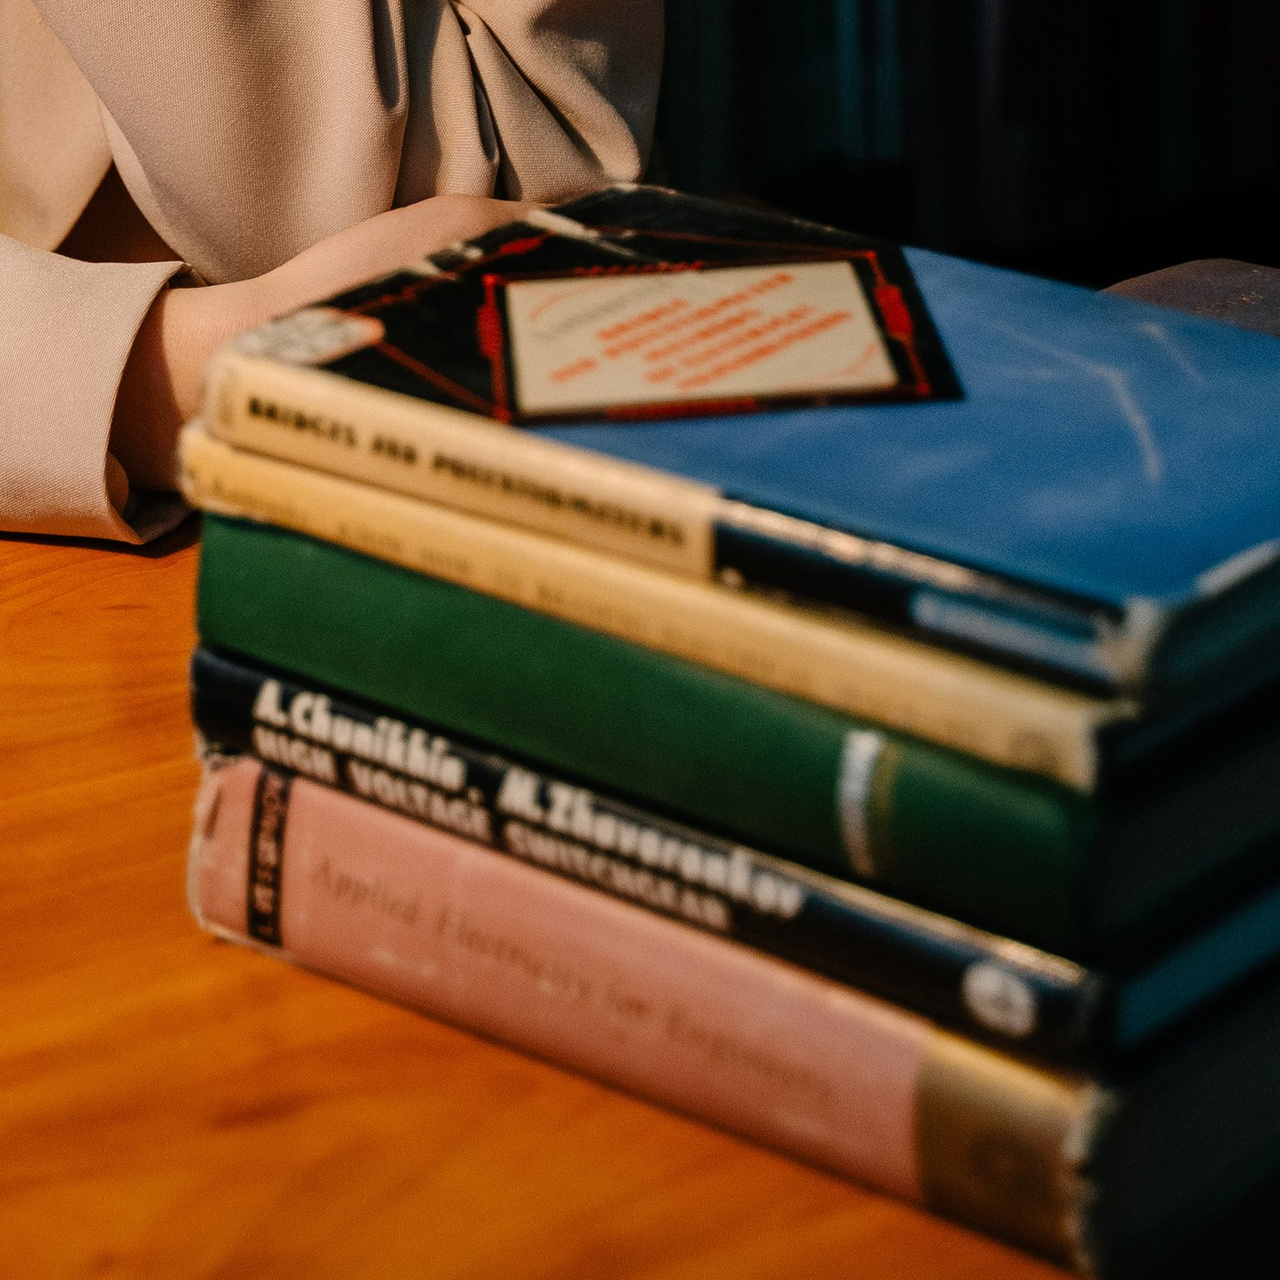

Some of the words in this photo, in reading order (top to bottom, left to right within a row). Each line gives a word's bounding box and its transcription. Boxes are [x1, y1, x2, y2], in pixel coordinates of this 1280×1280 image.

[253, 724, 338, 785] HIGH
[348, 758, 491, 842] VOLTAGE
[318, 858, 422, 930] Applied
